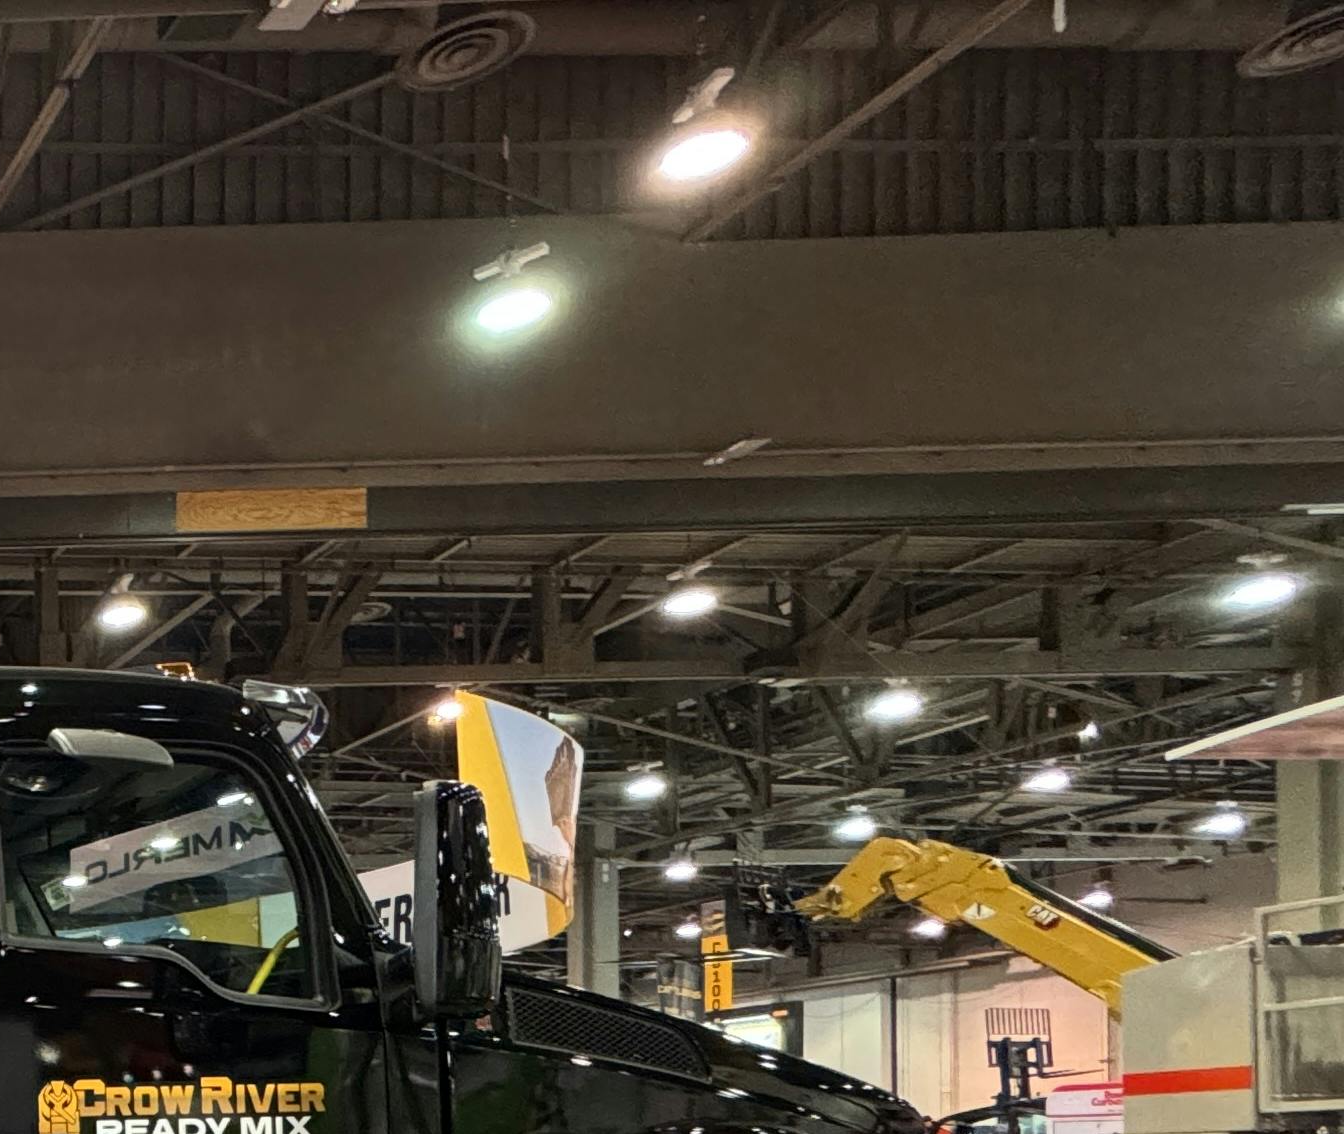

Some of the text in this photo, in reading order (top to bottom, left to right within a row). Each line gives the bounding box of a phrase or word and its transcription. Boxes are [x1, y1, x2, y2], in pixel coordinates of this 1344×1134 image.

[1025, 904, 1059, 925] CAT
[73, 1077, 326, 1117] CROW RIVER
